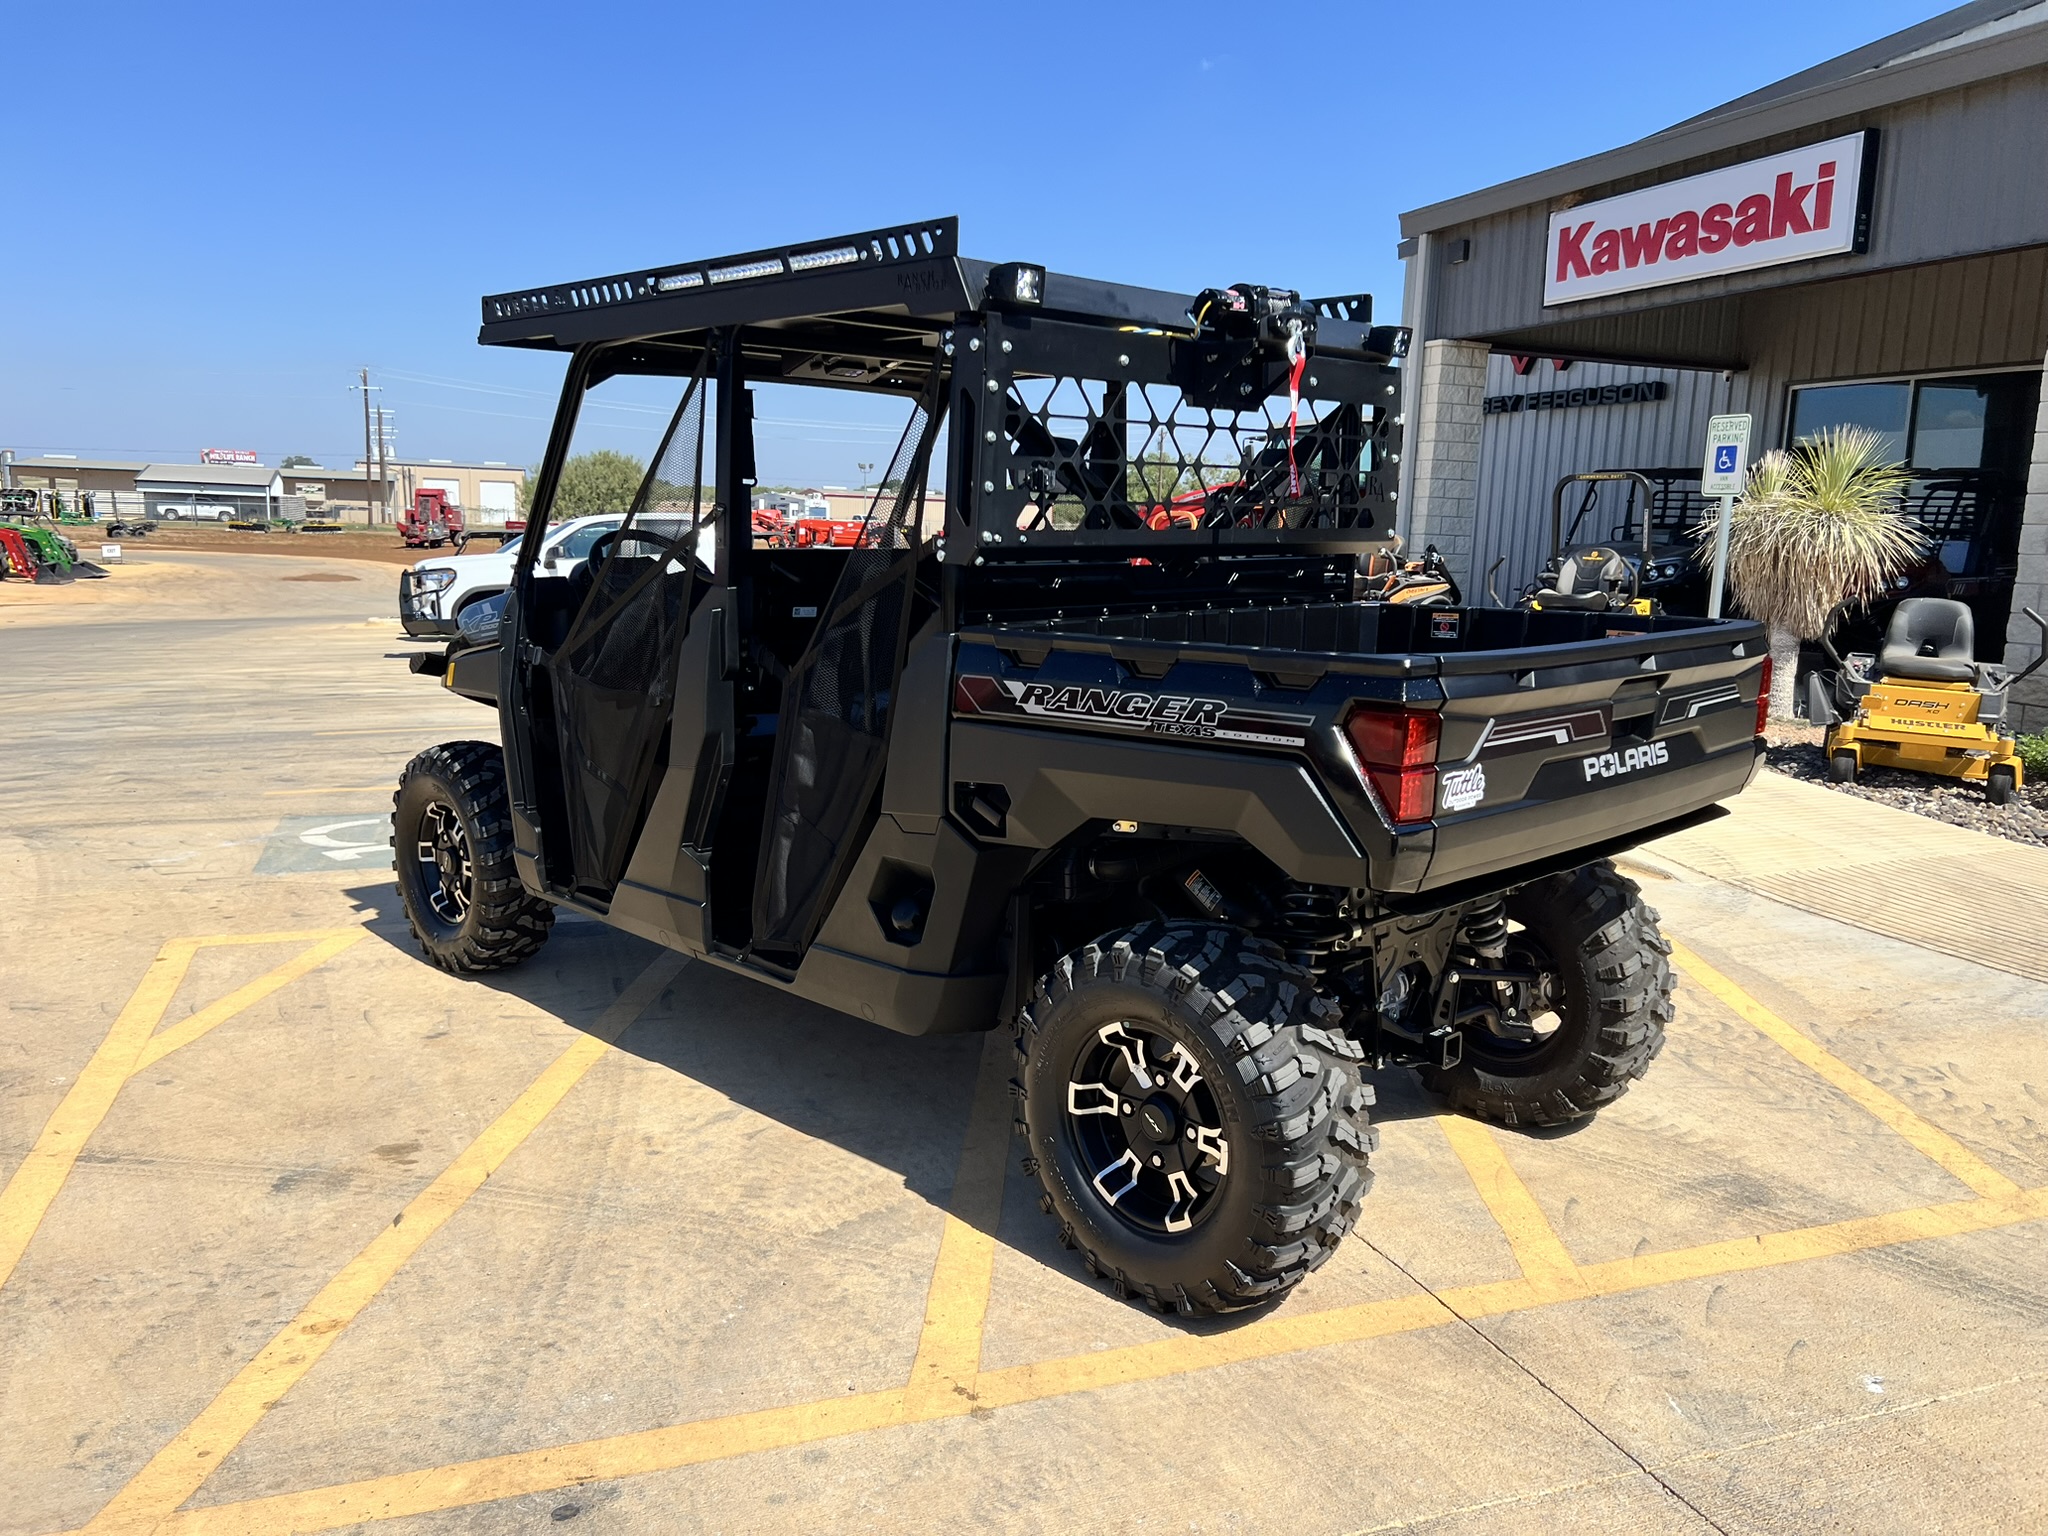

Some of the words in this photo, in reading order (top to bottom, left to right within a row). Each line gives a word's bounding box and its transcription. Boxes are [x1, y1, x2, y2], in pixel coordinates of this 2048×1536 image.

[1556, 161, 1837, 282] Kawasaki
[1526, 382, 1659, 411] FERGUSON
[1712, 421, 1747, 432] RESERVED
[1713, 433, 1744, 443] PARKING
[1289, 464, 1298, 494] WARN
[1016, 683, 1228, 725] RANGER
[1894, 699, 1950, 709] DASH
[1153, 721, 1217, 738] TEXAS
[1222, 731, 1296, 743] EDITION
[1891, 718, 1966, 730] HUSTLER
[1583, 741, 1669, 781] POLARIS
[1443, 765, 1484, 807] Tuttle
